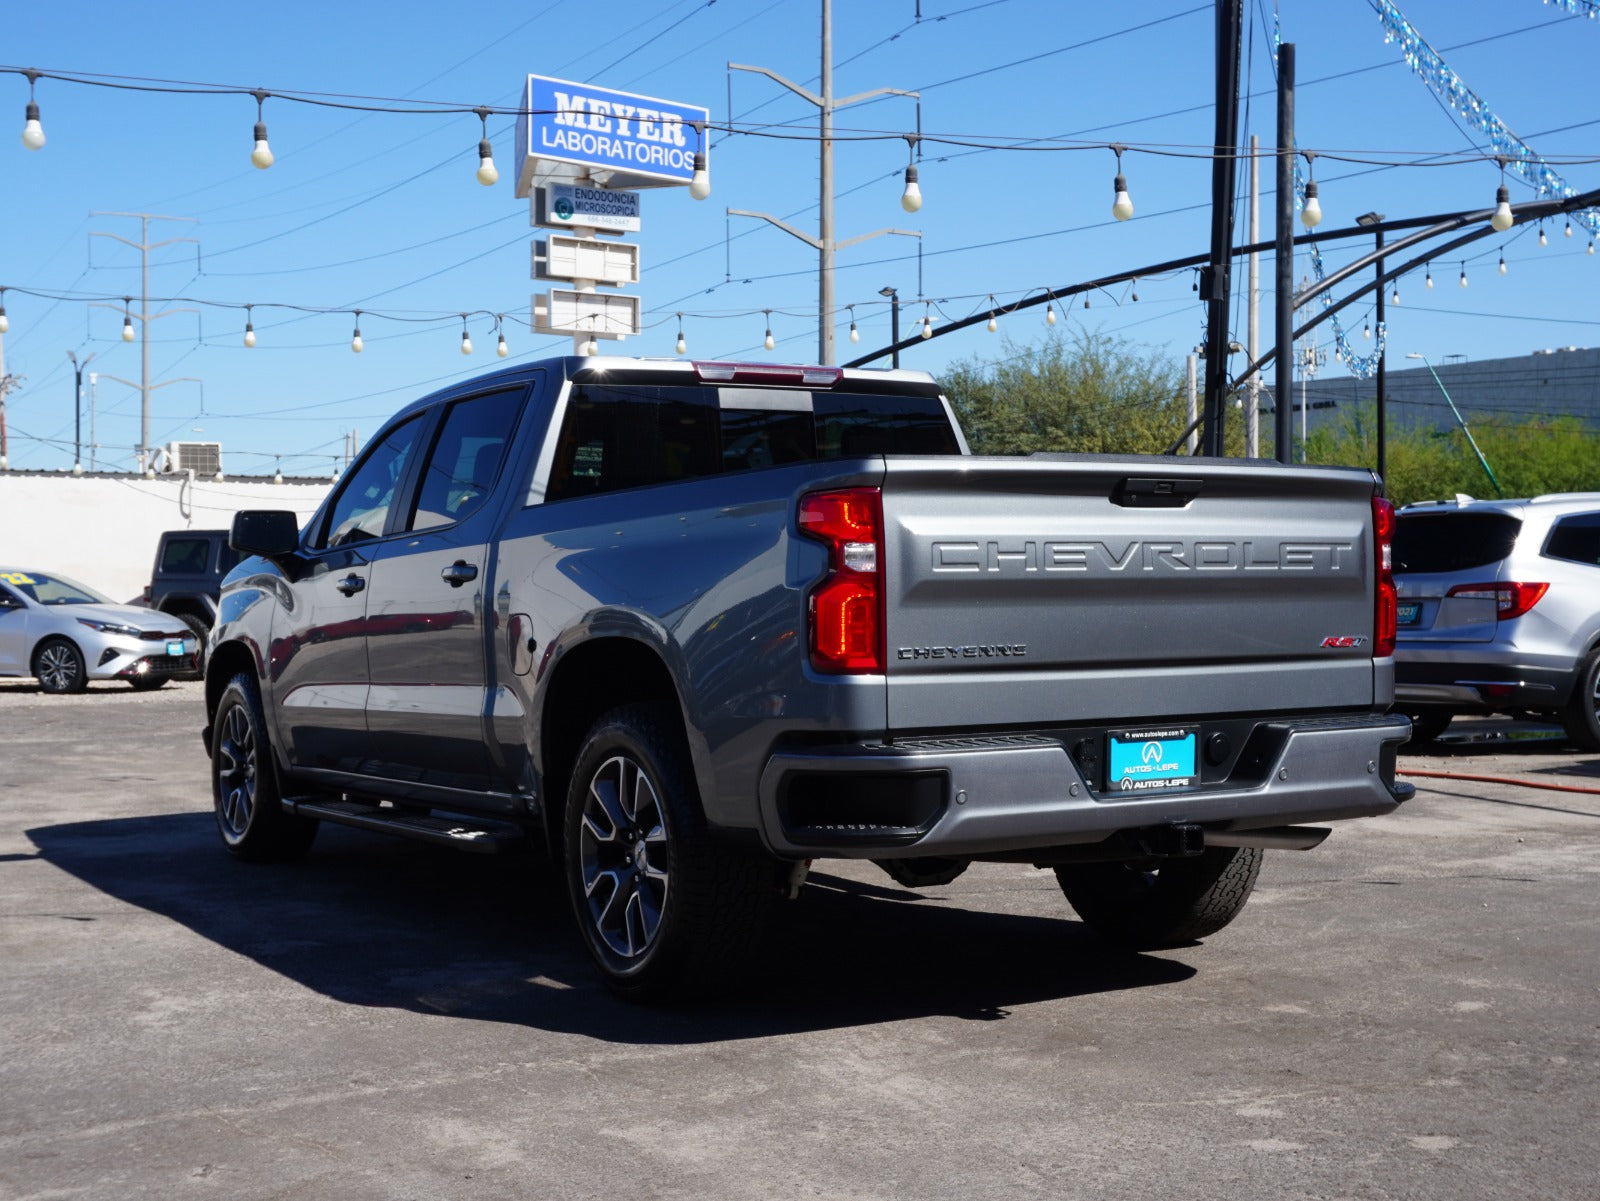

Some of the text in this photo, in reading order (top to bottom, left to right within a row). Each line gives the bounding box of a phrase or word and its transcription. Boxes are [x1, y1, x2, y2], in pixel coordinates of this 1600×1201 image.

[553, 91, 686, 147] MEYER
[542, 126, 694, 170] LABORATORIOS
[574, 187, 636, 206] ENDODONCIA
[574, 201, 636, 217] MICROSCOPICA
[931, 541, 1352, 572] CHEVROLET
[1319, 635, 1368, 649] RST
[897, 644, 1027, 660] CHEYENNE
[1131, 730, 1179, 738] www.autoslepe.com
